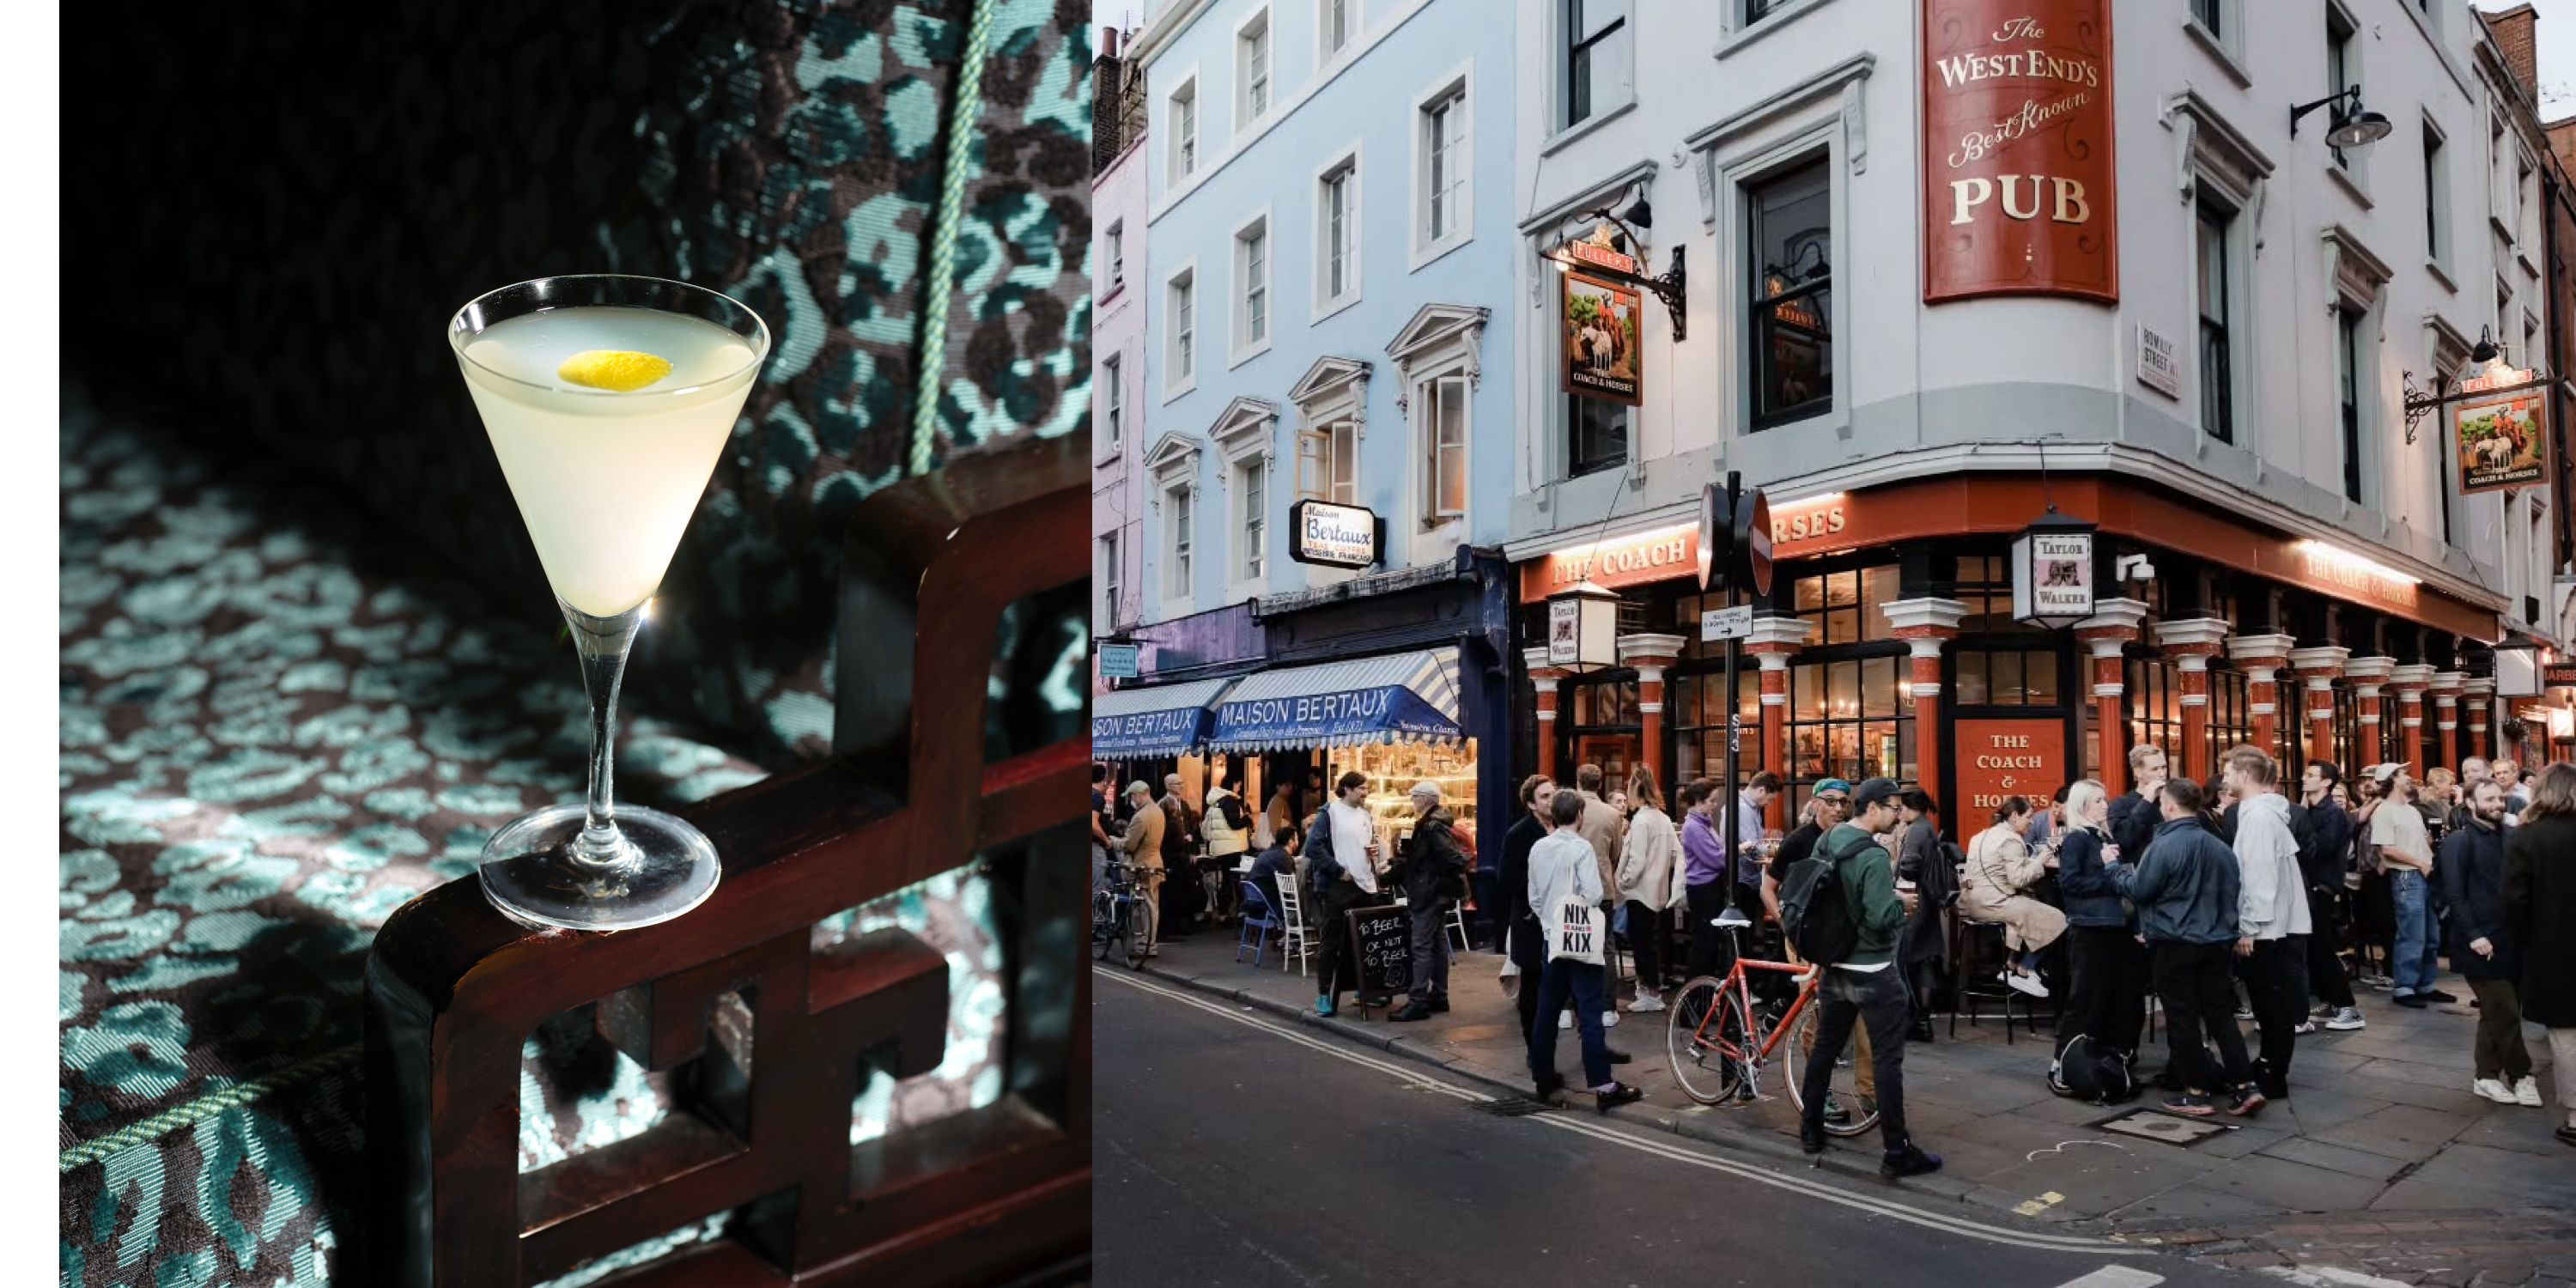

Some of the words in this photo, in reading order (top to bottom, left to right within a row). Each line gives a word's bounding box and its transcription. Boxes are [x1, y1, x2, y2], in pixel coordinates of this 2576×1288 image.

[1992, 15, 2045, 41] The
[1936, 53, 2023, 88] WEST
[2026, 50, 2098, 88] END'S
[1948, 120, 2014, 168] Best
[2013, 92, 2091, 139] Known
[1950, 173, 2090, 225] PUB
[2144, 346, 2168, 372] STREET
[1573, 372, 1598, 386] COACH
[1606, 379, 1634, 393] HORSES
[1305, 505, 1340, 519] Maison
[1306, 517, 1371, 545] Bertaux
[1552, 558, 1592, 586] THE
[1601, 538, 1686, 575] COACH
[1771, 507, 1845, 544] RSES
[2040, 542, 2084, 555] TAYLOR
[2038, 591, 2087, 604] WALKER
[1220, 700, 1291, 726] MAISON
[1296, 690, 1391, 722] BERTAUX
[1125, 708, 1194, 735] BERTAUX
[1990, 734, 2030, 748] THE
[1976, 755, 2042, 769] COACH
[2001, 775, 2017, 788] &
[1973, 794, 2050, 808] HOES
[1564, 903, 1590, 925] NIX
[1370, 917, 1403, 935] BEER
[1366, 941, 1381, 953] OR
[1385, 936, 1402, 947] NOT
[1563, 931, 1591, 953] KIX
[1381, 948, 1408, 968] BEER
